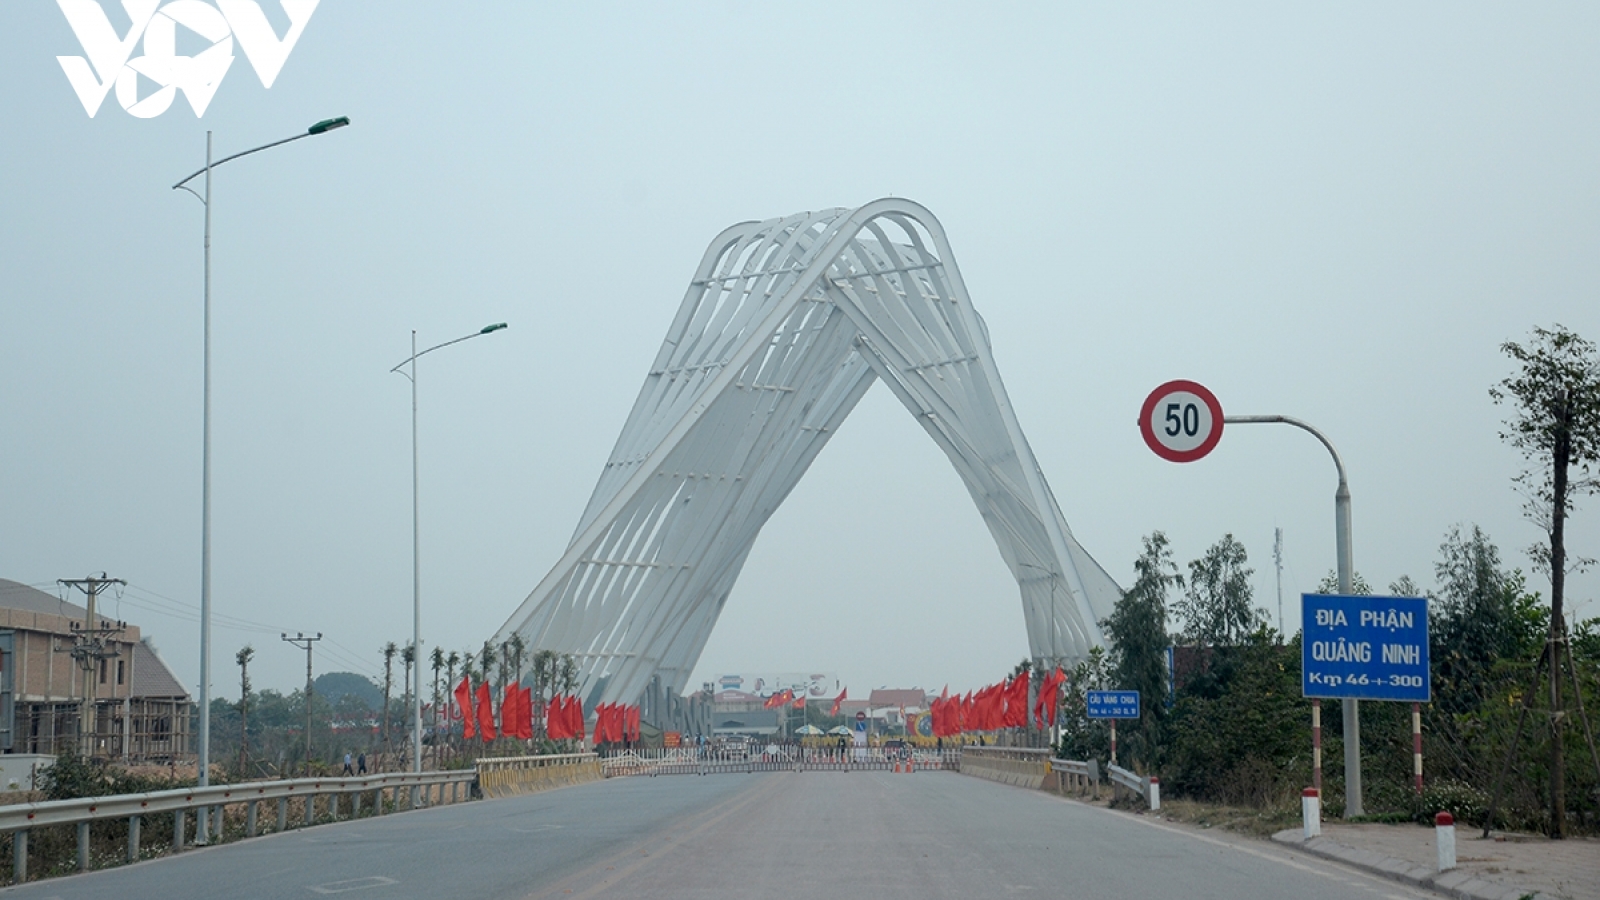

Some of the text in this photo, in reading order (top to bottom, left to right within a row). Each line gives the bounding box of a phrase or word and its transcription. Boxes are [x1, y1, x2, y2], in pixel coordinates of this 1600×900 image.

[1165, 403, 1199, 437] 50
[1316, 609, 1413, 632] ĐỊA PHẬN
[1312, 637, 1420, 665] QUẢNG NINH
[1309, 672, 1342, 686] Km
